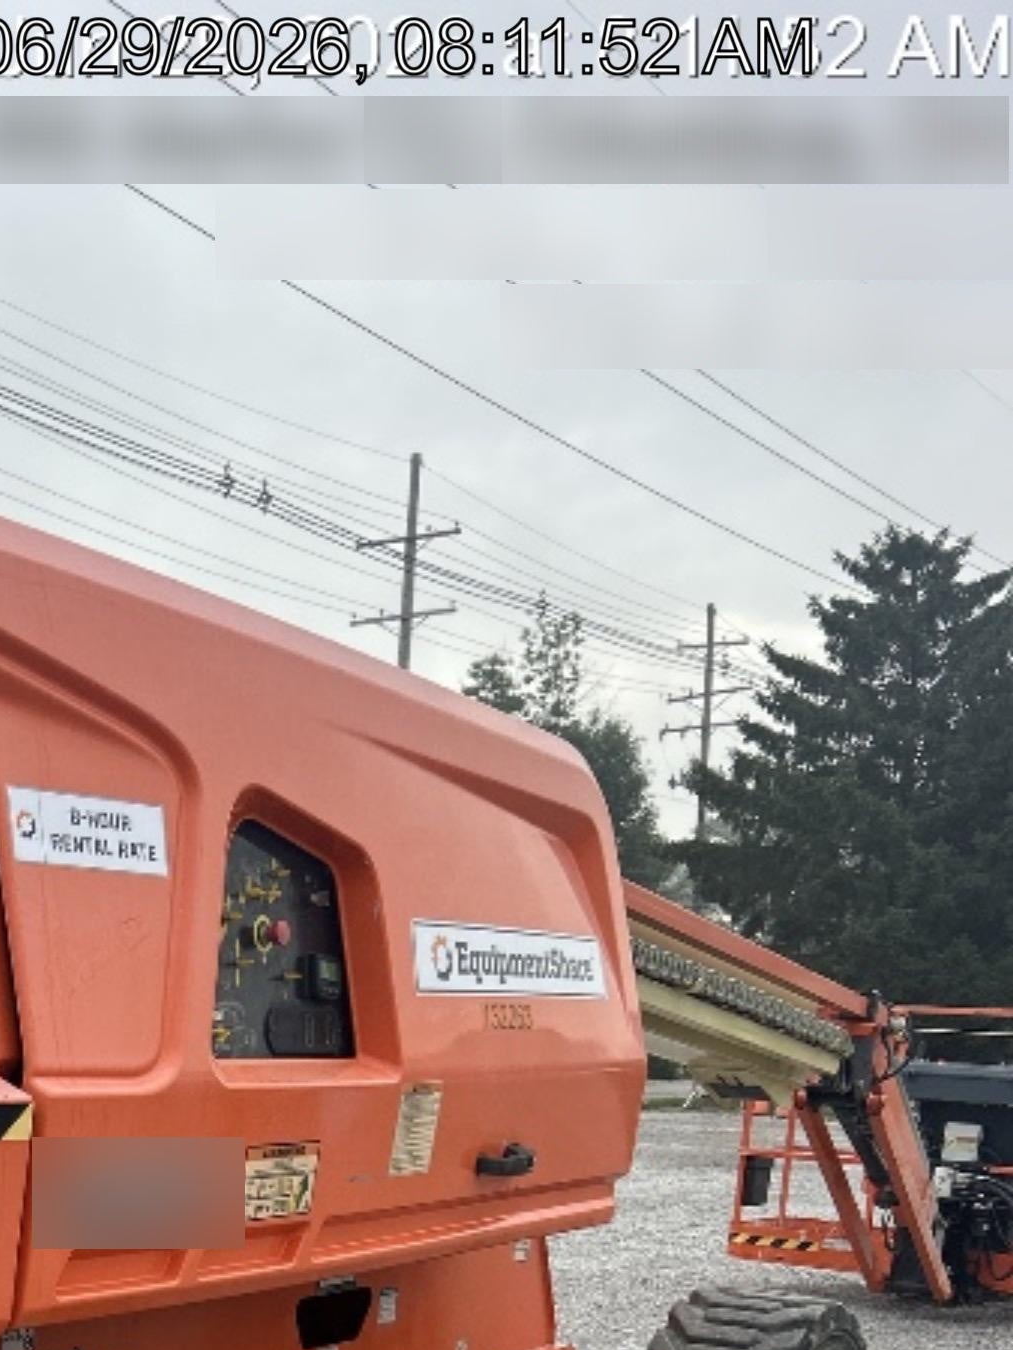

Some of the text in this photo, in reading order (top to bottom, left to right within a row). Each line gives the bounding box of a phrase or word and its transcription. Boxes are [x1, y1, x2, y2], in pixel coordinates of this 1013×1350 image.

[49, 832, 159, 862] RENTAL RATE
[454, 940, 595, 985] EquipmentShare
